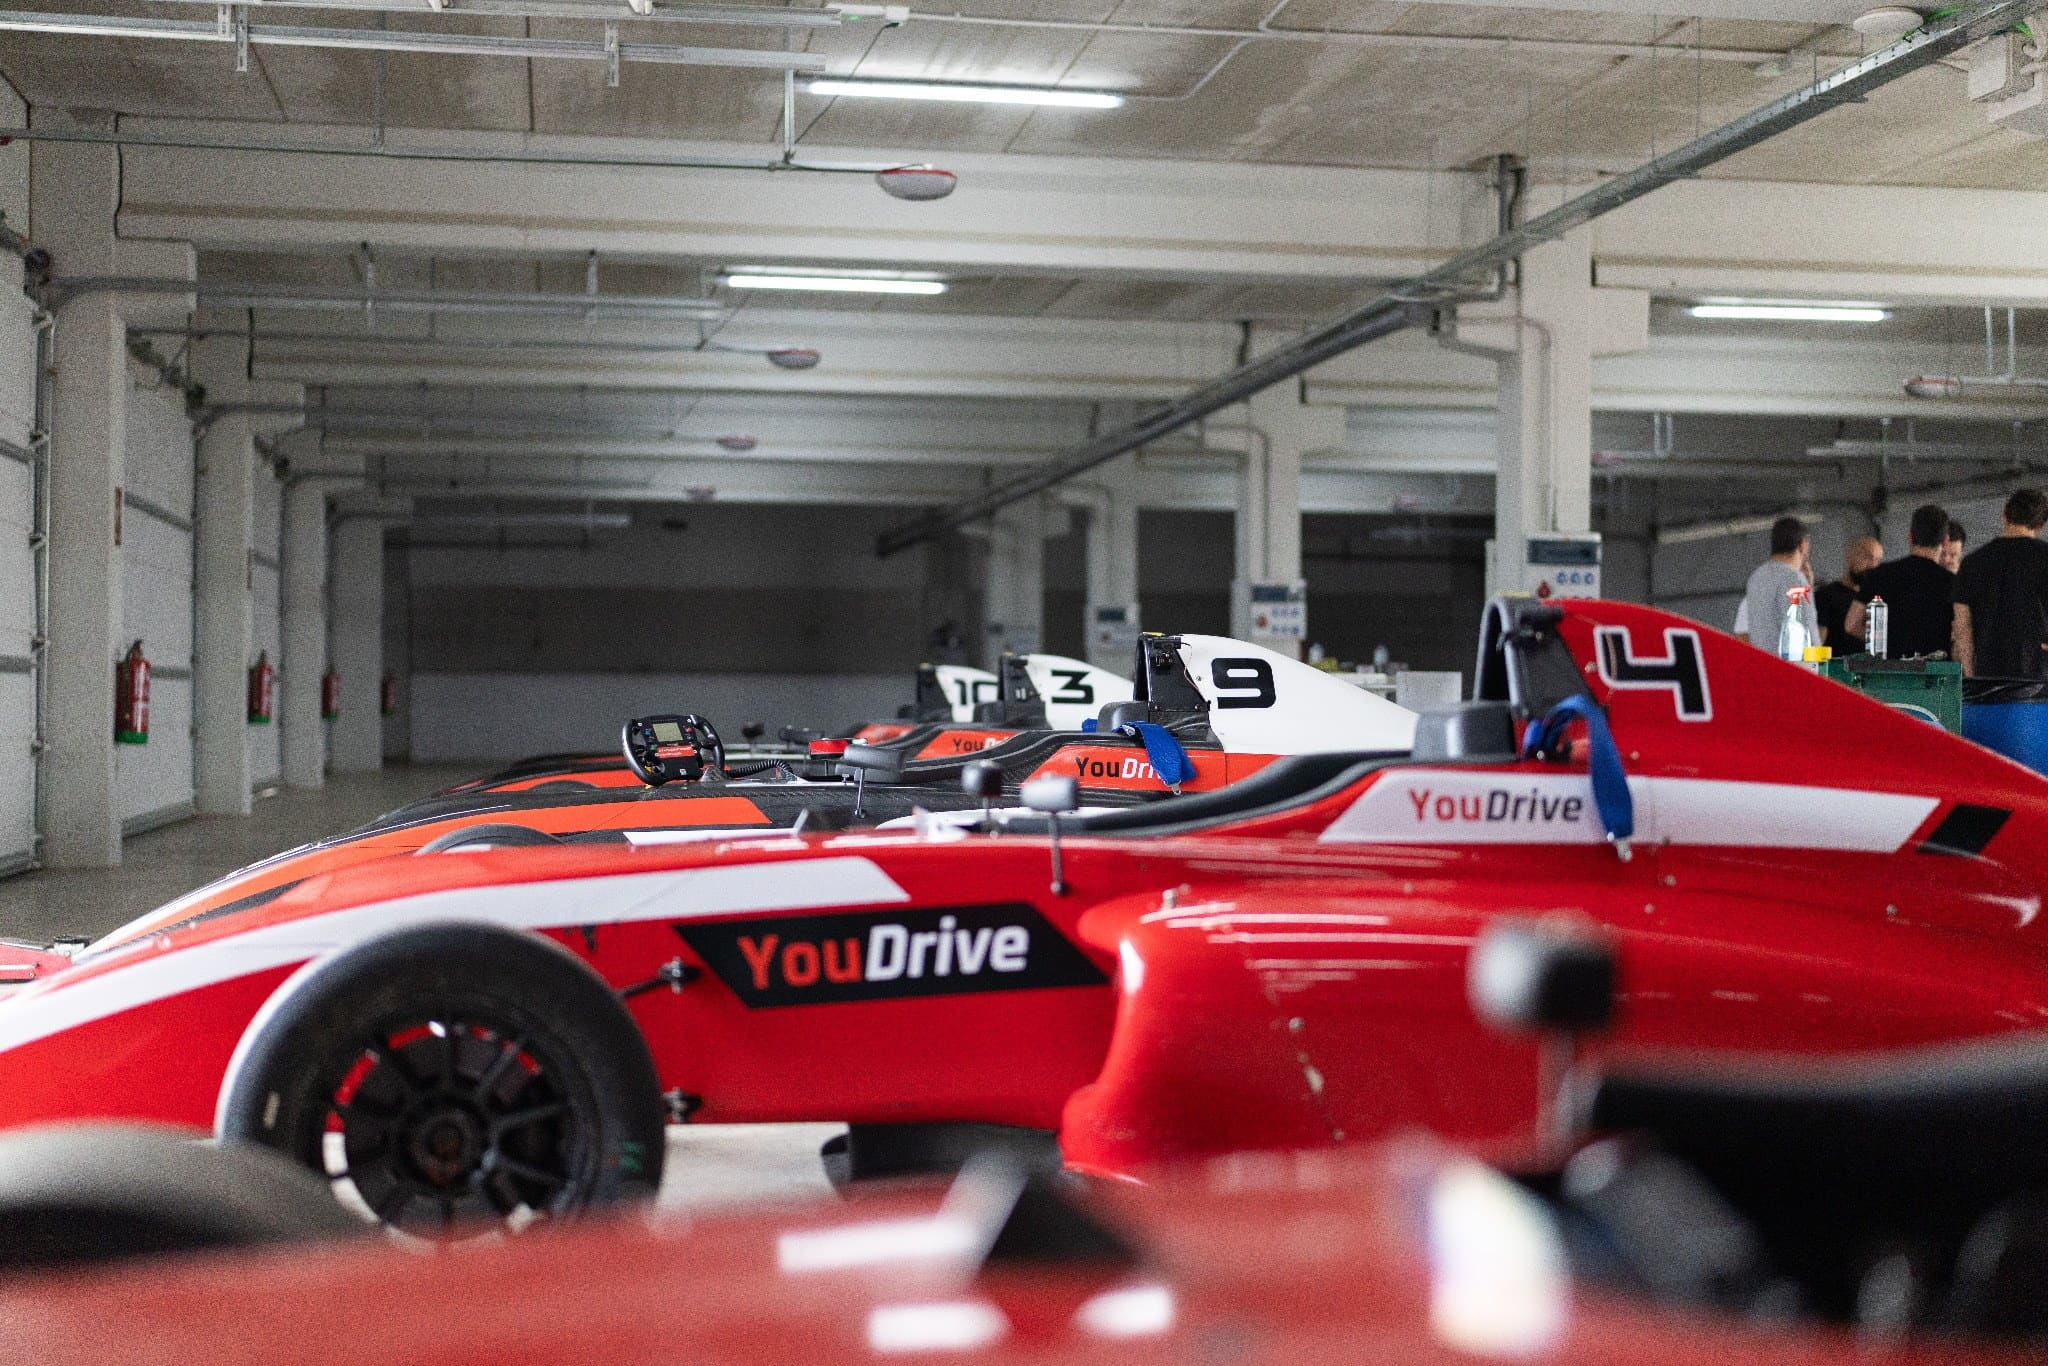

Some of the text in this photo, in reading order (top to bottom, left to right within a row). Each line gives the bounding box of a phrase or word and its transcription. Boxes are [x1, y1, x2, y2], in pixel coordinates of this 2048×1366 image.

[1051, 669, 1094, 704] 3
[1211, 657, 1276, 709] 9
[1593, 625, 1713, 722] 4
[953, 736, 1010, 752] YouD
[1075, 757, 1161, 779] YouDri
[1409, 788, 1583, 823] YouDrive
[736, 914, 1031, 990] YouDrive
